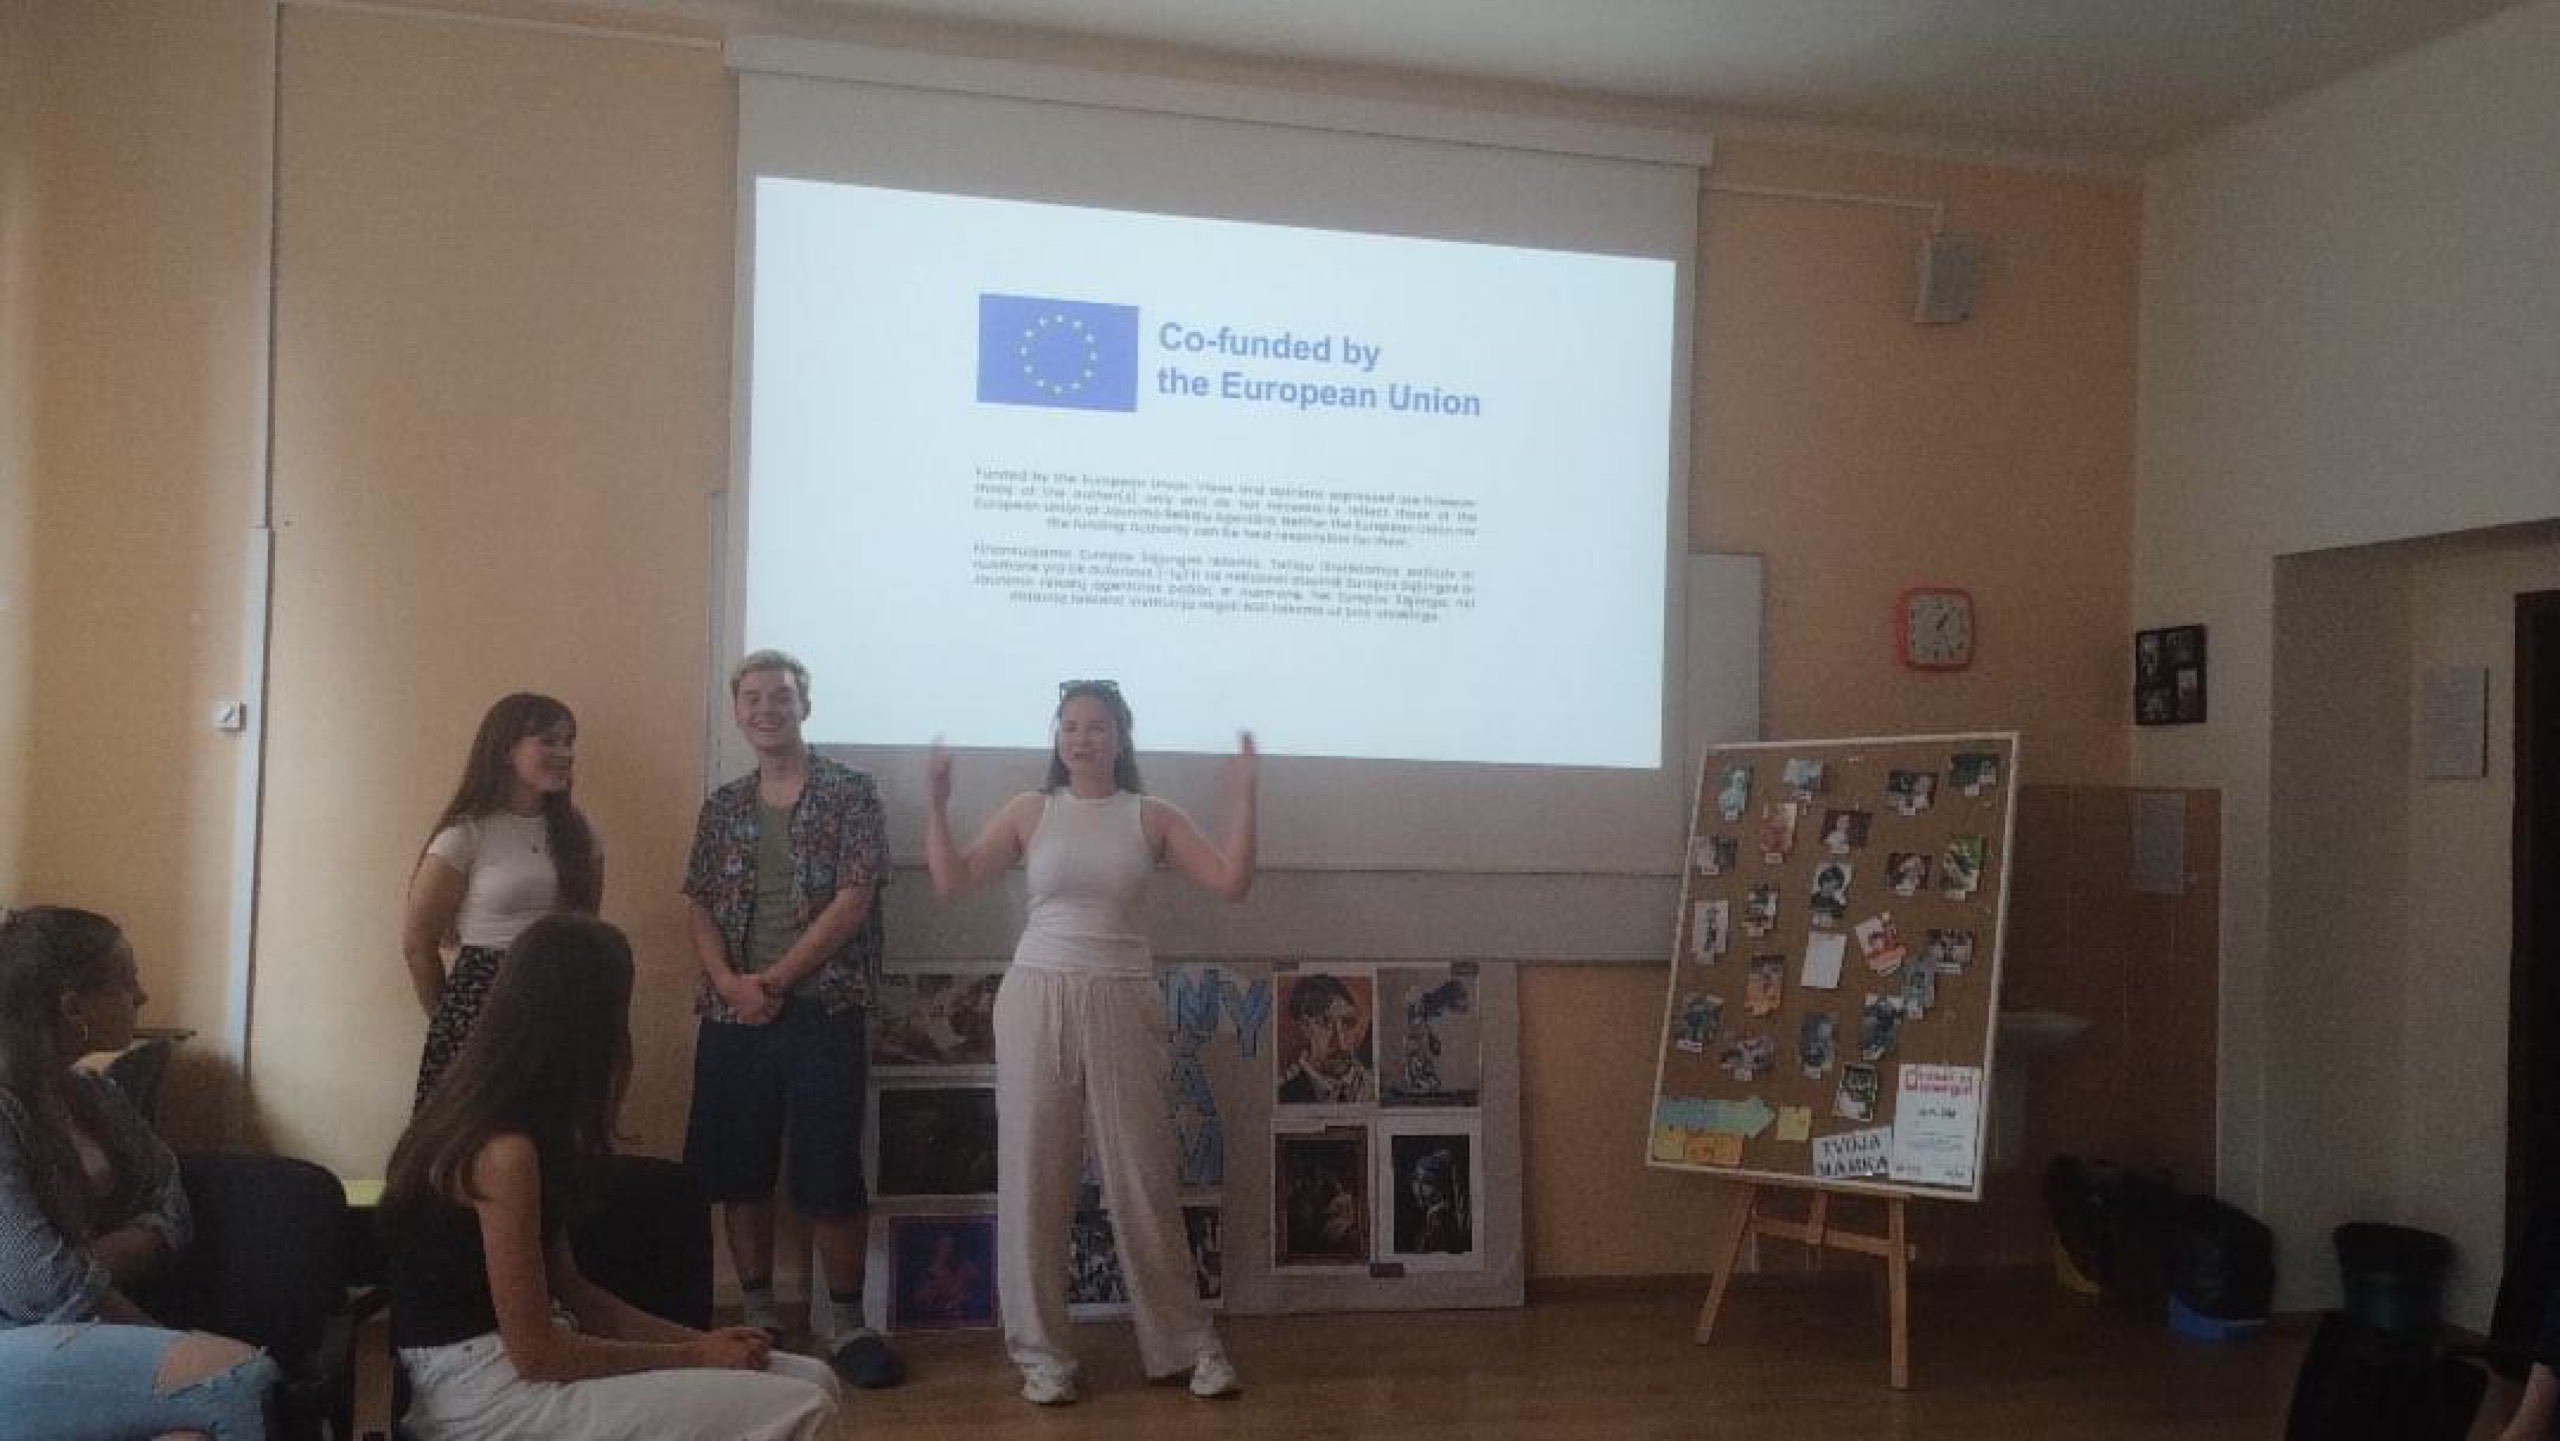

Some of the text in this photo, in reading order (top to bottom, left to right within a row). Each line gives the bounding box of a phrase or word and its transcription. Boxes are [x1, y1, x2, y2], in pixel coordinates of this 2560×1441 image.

[1158, 321, 1382, 373] Co-funded by
[1157, 367, 1481, 417] the European Union
